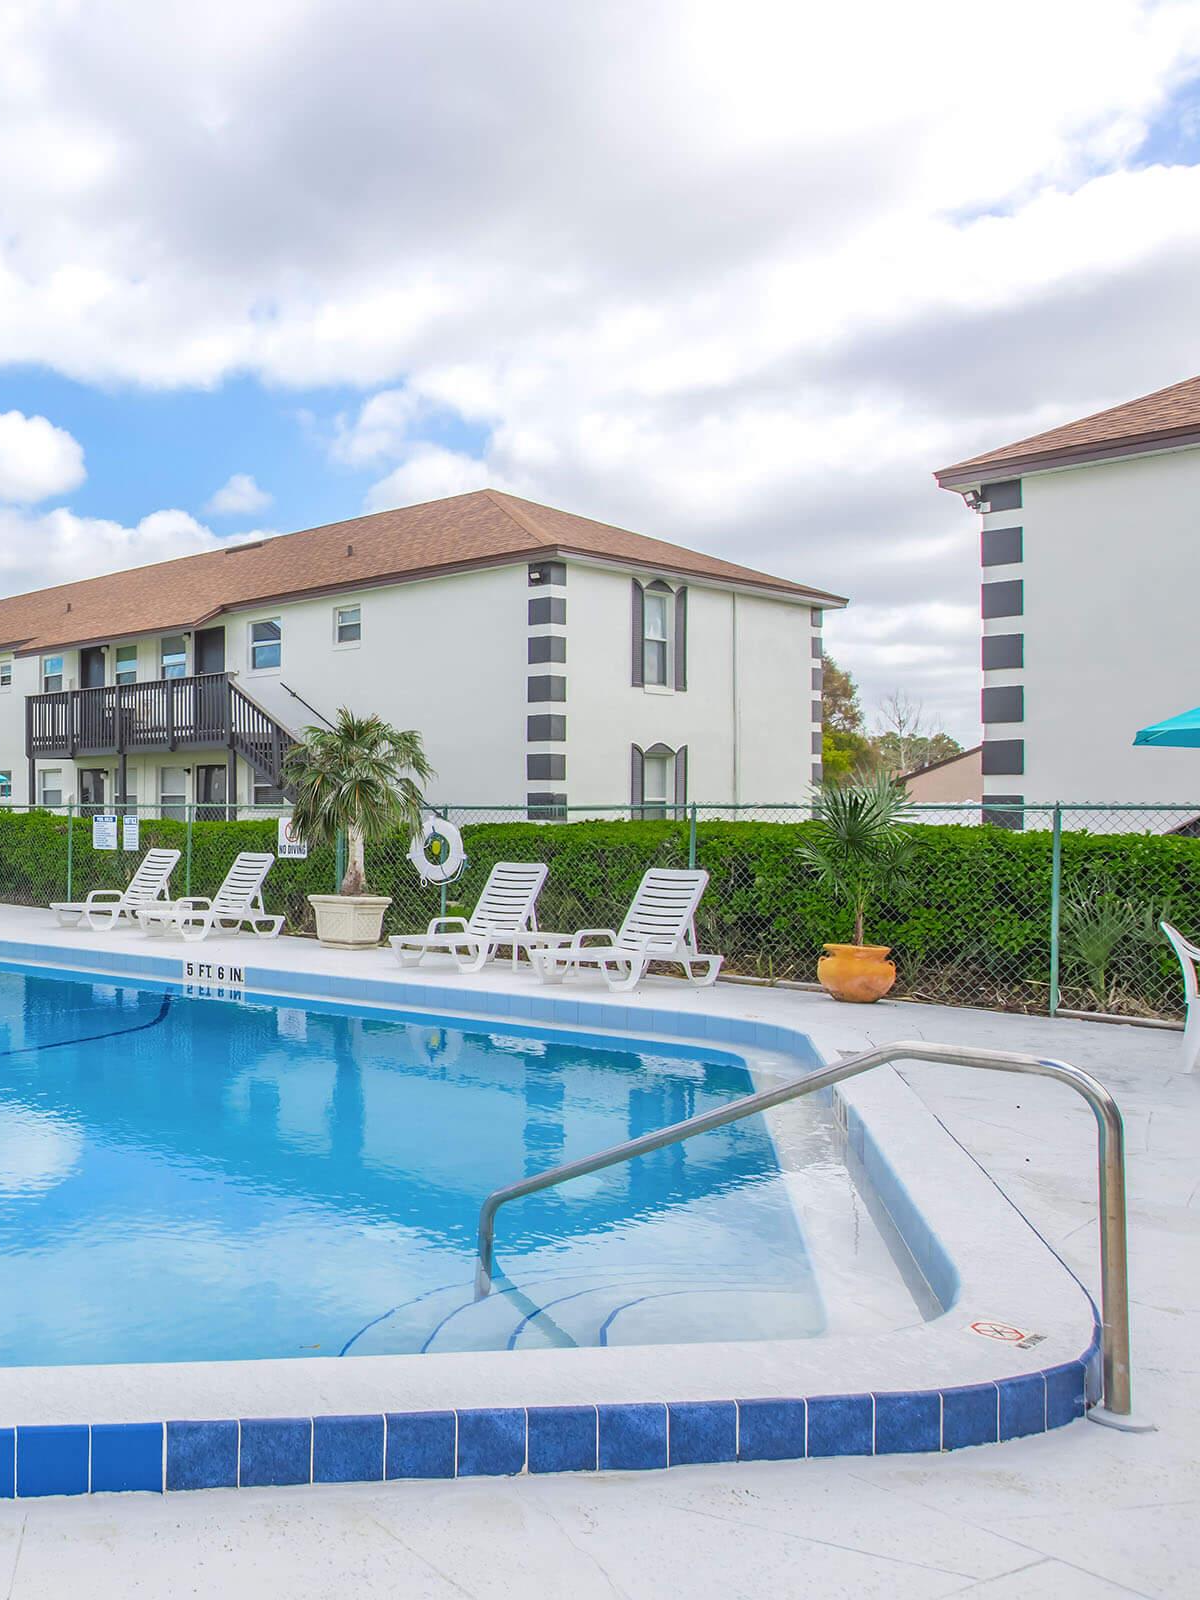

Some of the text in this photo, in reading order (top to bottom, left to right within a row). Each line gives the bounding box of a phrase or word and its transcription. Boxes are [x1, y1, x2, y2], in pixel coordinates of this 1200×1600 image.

[187, 963, 244, 982] 5 FT. 6 IN.
